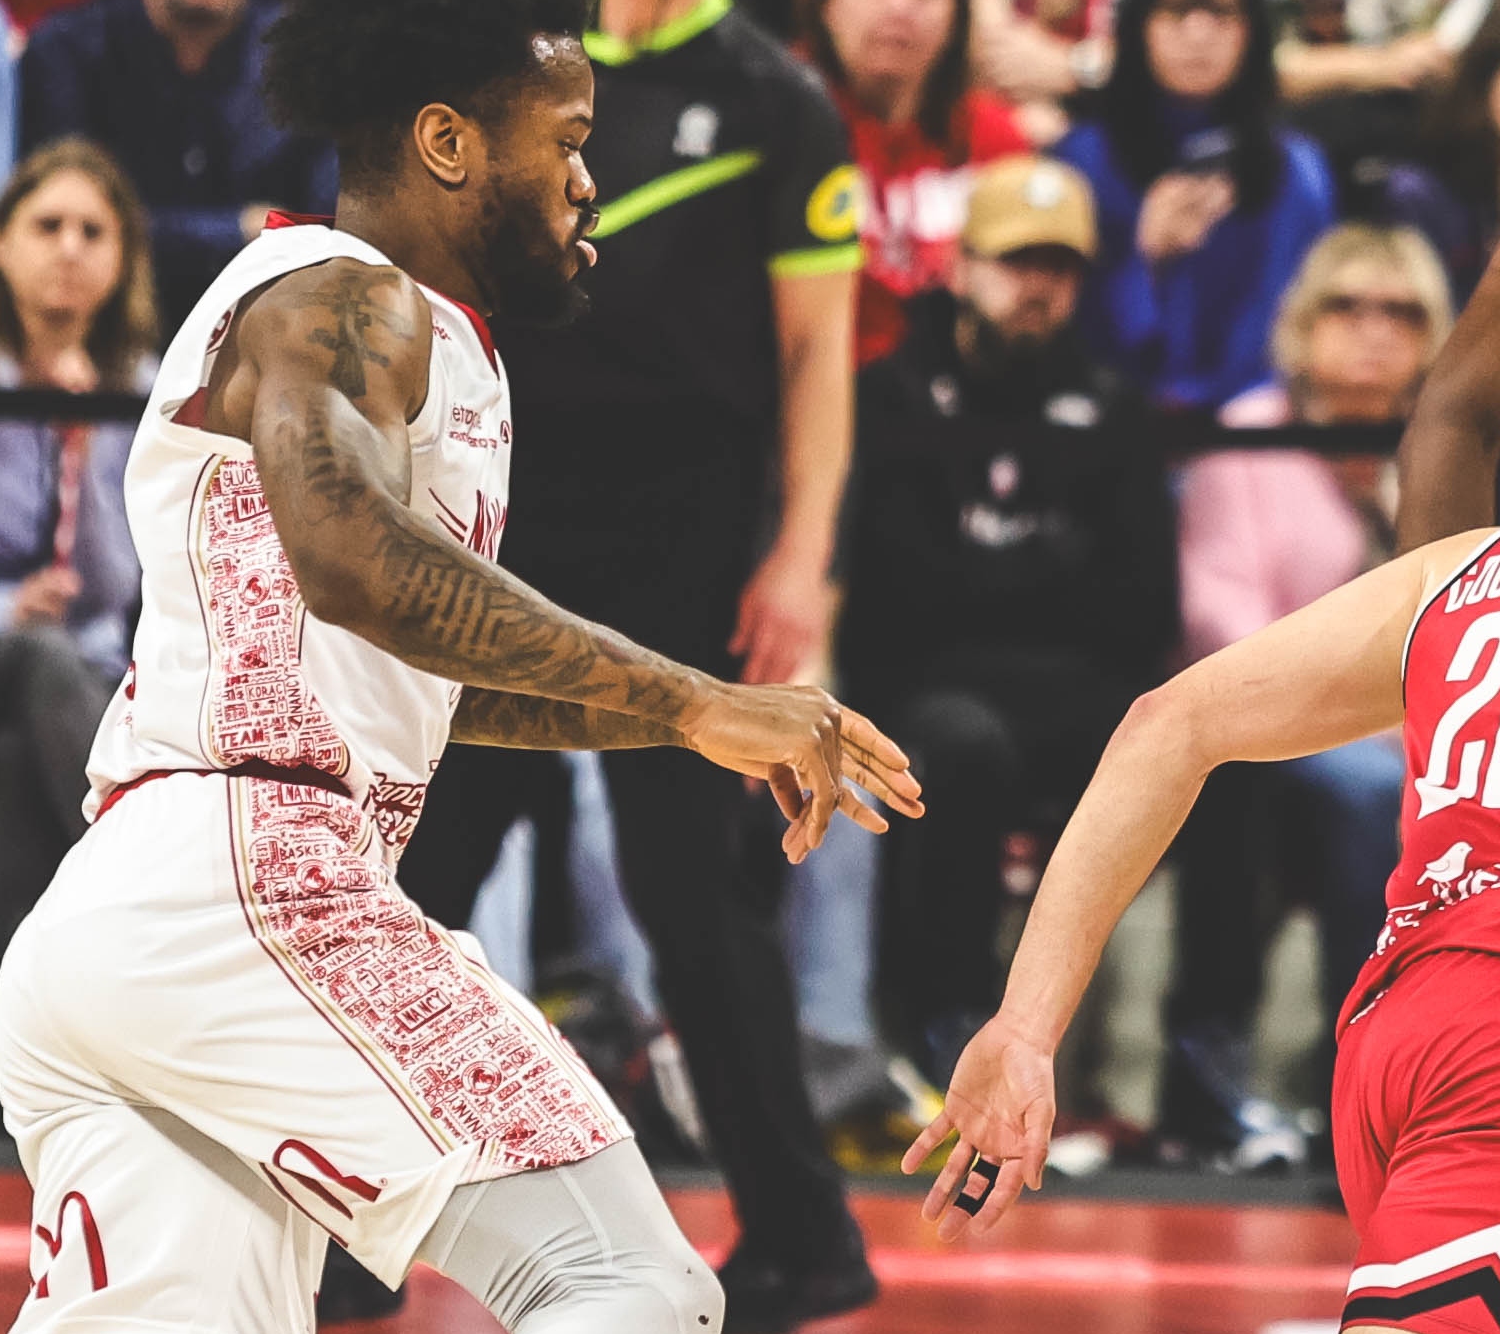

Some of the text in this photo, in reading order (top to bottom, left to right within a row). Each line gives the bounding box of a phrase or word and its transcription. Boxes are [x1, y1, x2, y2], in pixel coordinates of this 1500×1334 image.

[240, 495, 269, 516] NAN
[219, 728, 265, 749] TEAM
[401, 990, 447, 1024] NANCY
